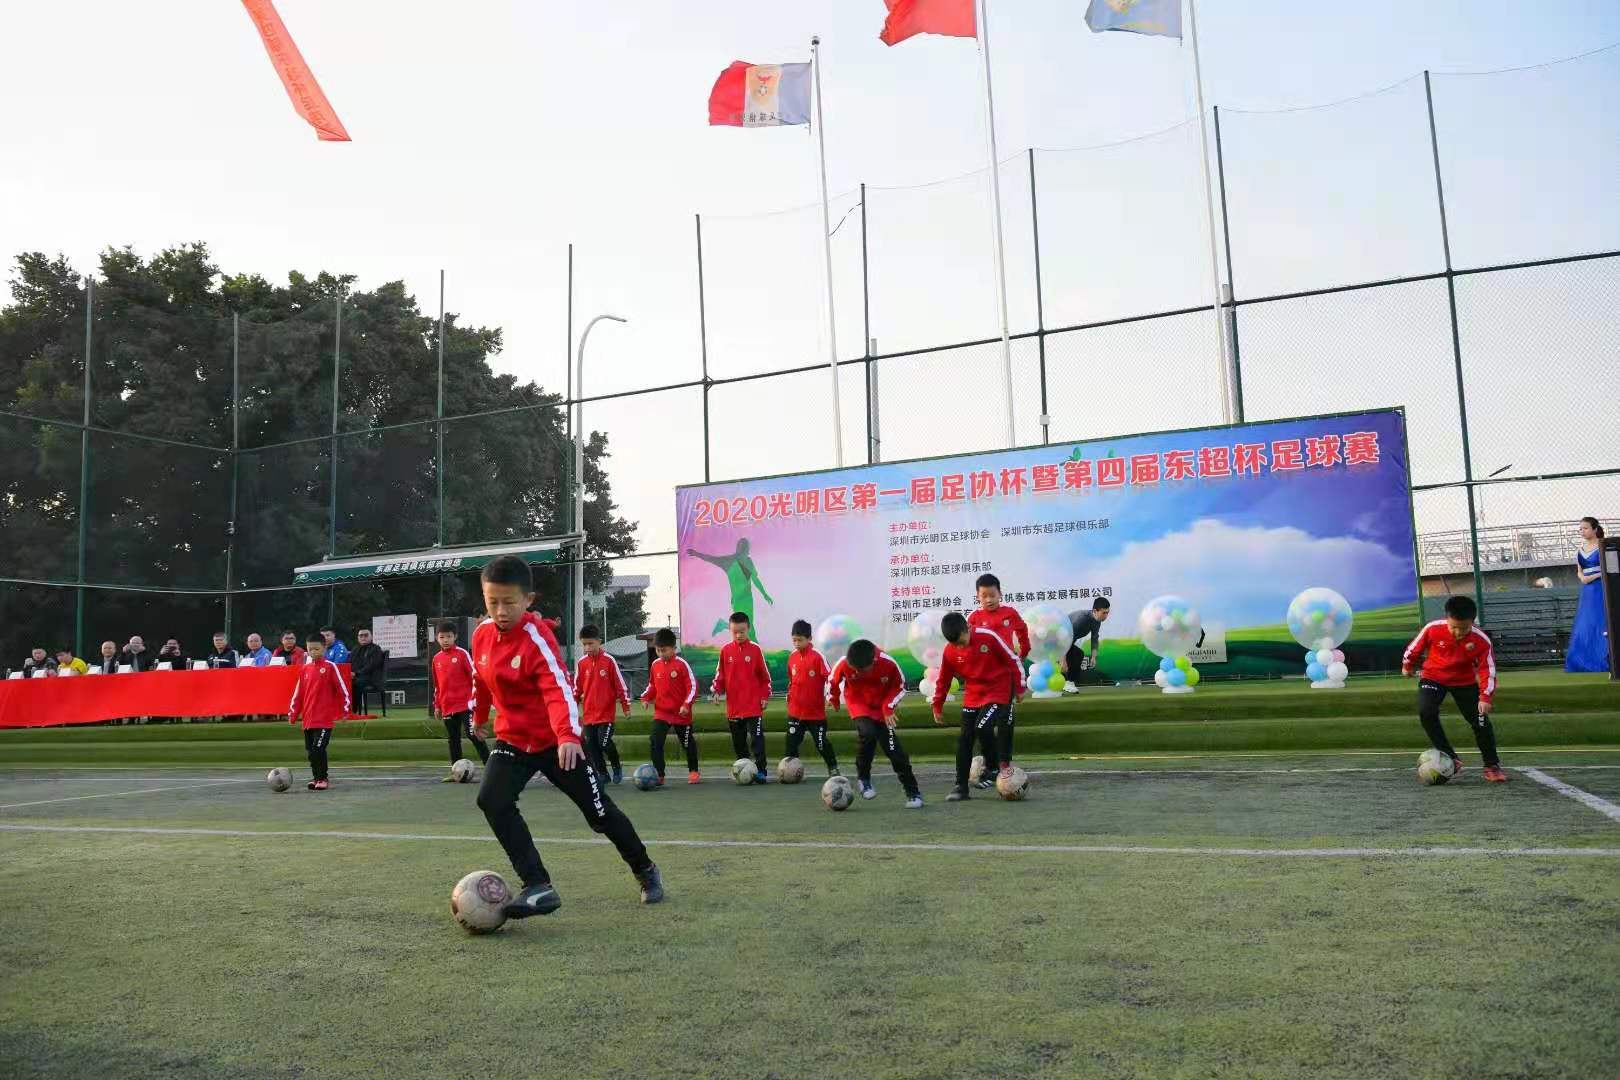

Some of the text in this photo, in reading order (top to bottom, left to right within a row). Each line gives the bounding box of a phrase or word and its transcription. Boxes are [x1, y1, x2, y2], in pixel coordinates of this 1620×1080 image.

[693, 431, 1381, 528] 2020光明区第一届足协杯暨第四届东超杯足球赛
[889, 518, 1110, 547] 深圳市光明区足球协会 深圳市东超足球俱乐部
[890, 561, 992, 578] 深圳市东超足球俱乐部
[892, 596, 962, 610] 深圳市足球协会
[588, 774, 606, 817] KELME
